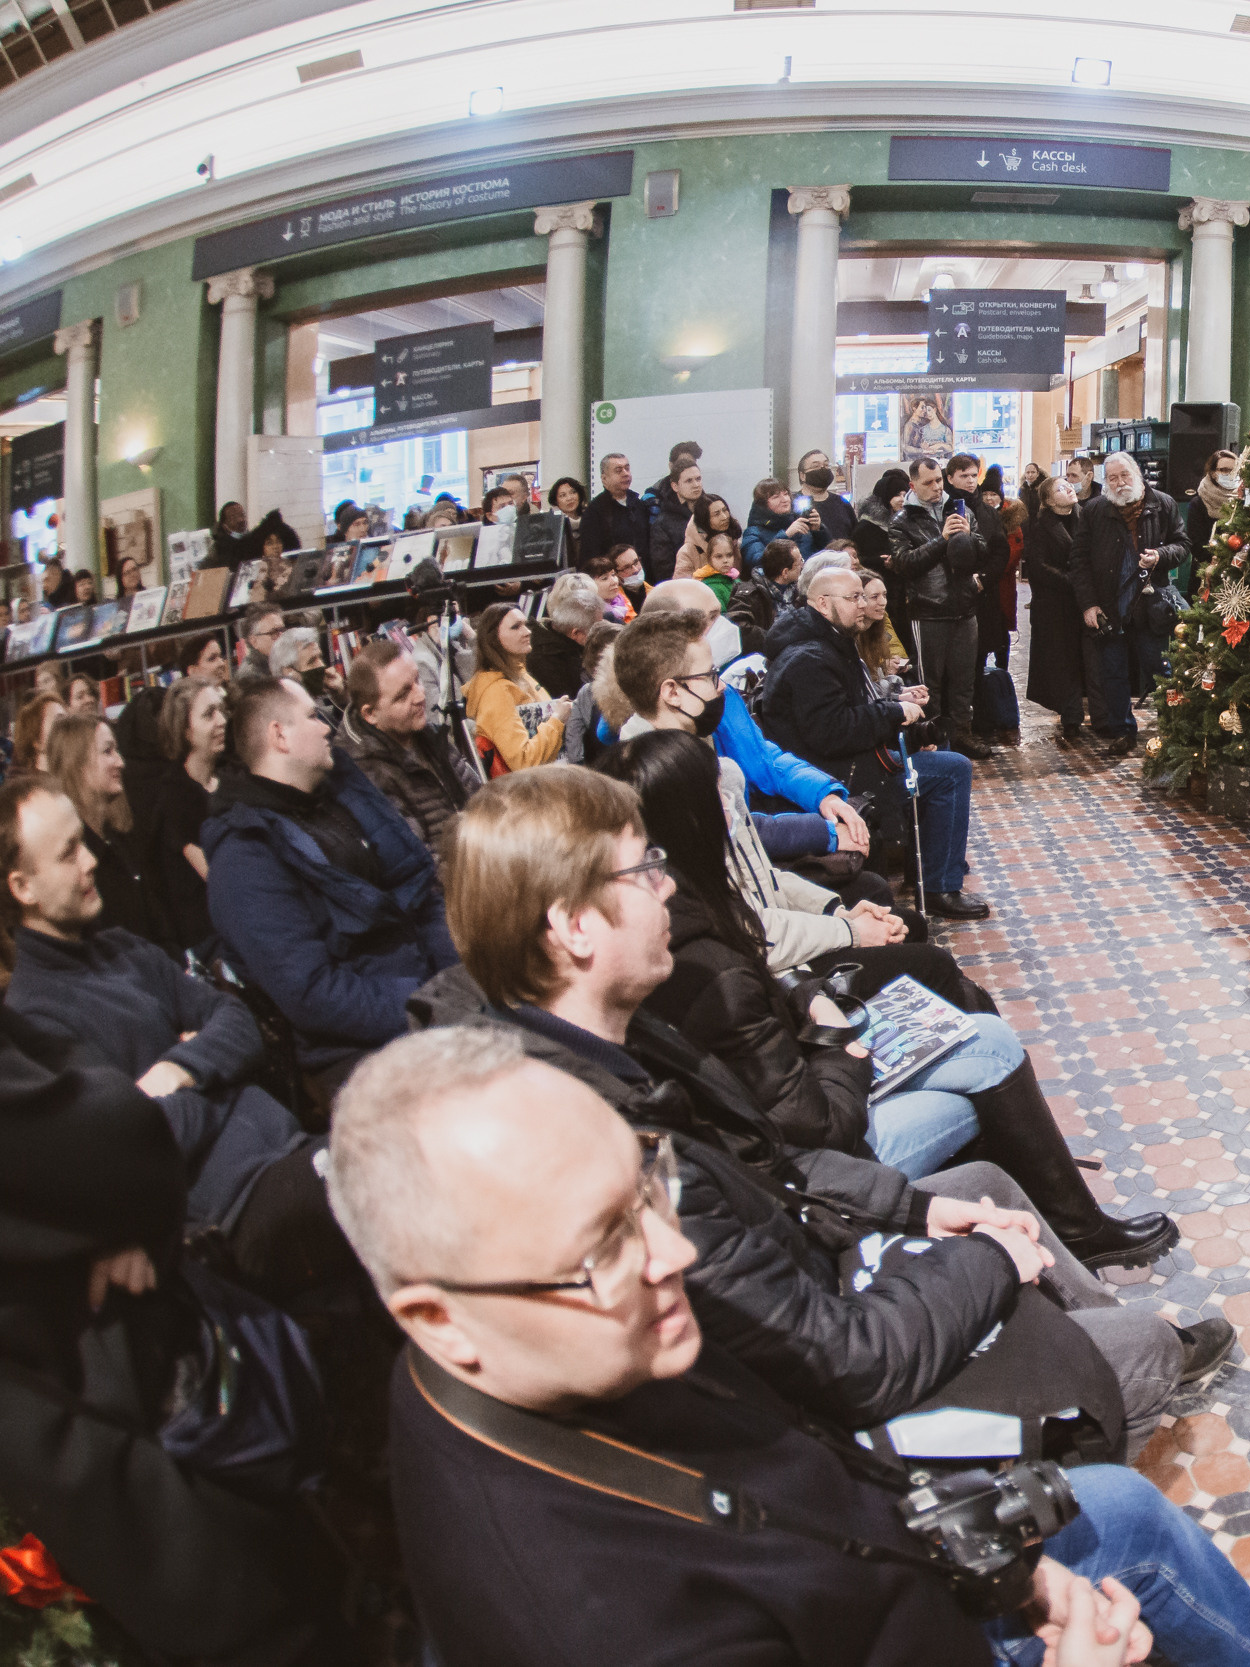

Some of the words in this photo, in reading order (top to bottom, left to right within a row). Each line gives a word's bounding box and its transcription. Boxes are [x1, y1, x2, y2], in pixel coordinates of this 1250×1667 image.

[1032, 150, 1076, 161] КАССЫ
[1032, 161, 1058, 172] Cash
[1061, 163, 1087, 173] desk
[319, 209, 350, 222] МОДА
[361, 199, 396, 215] СТИЛЬ
[400, 188, 450, 204] ИСТОРИЯ
[452, 178, 510, 195] КОСТЮМА
[353, 215, 370, 225] and
[372, 209, 395, 222] style
[400, 206, 417, 216] The
[454, 196, 467, 206] of
[468, 188, 511, 203] costume
[978, 301, 1018, 310] ОТКРЫТКИ,
[978, 308, 1008, 317] Postcard,
[977, 325, 1035, 333] ПУТЕВОДИТЕЛИ,
